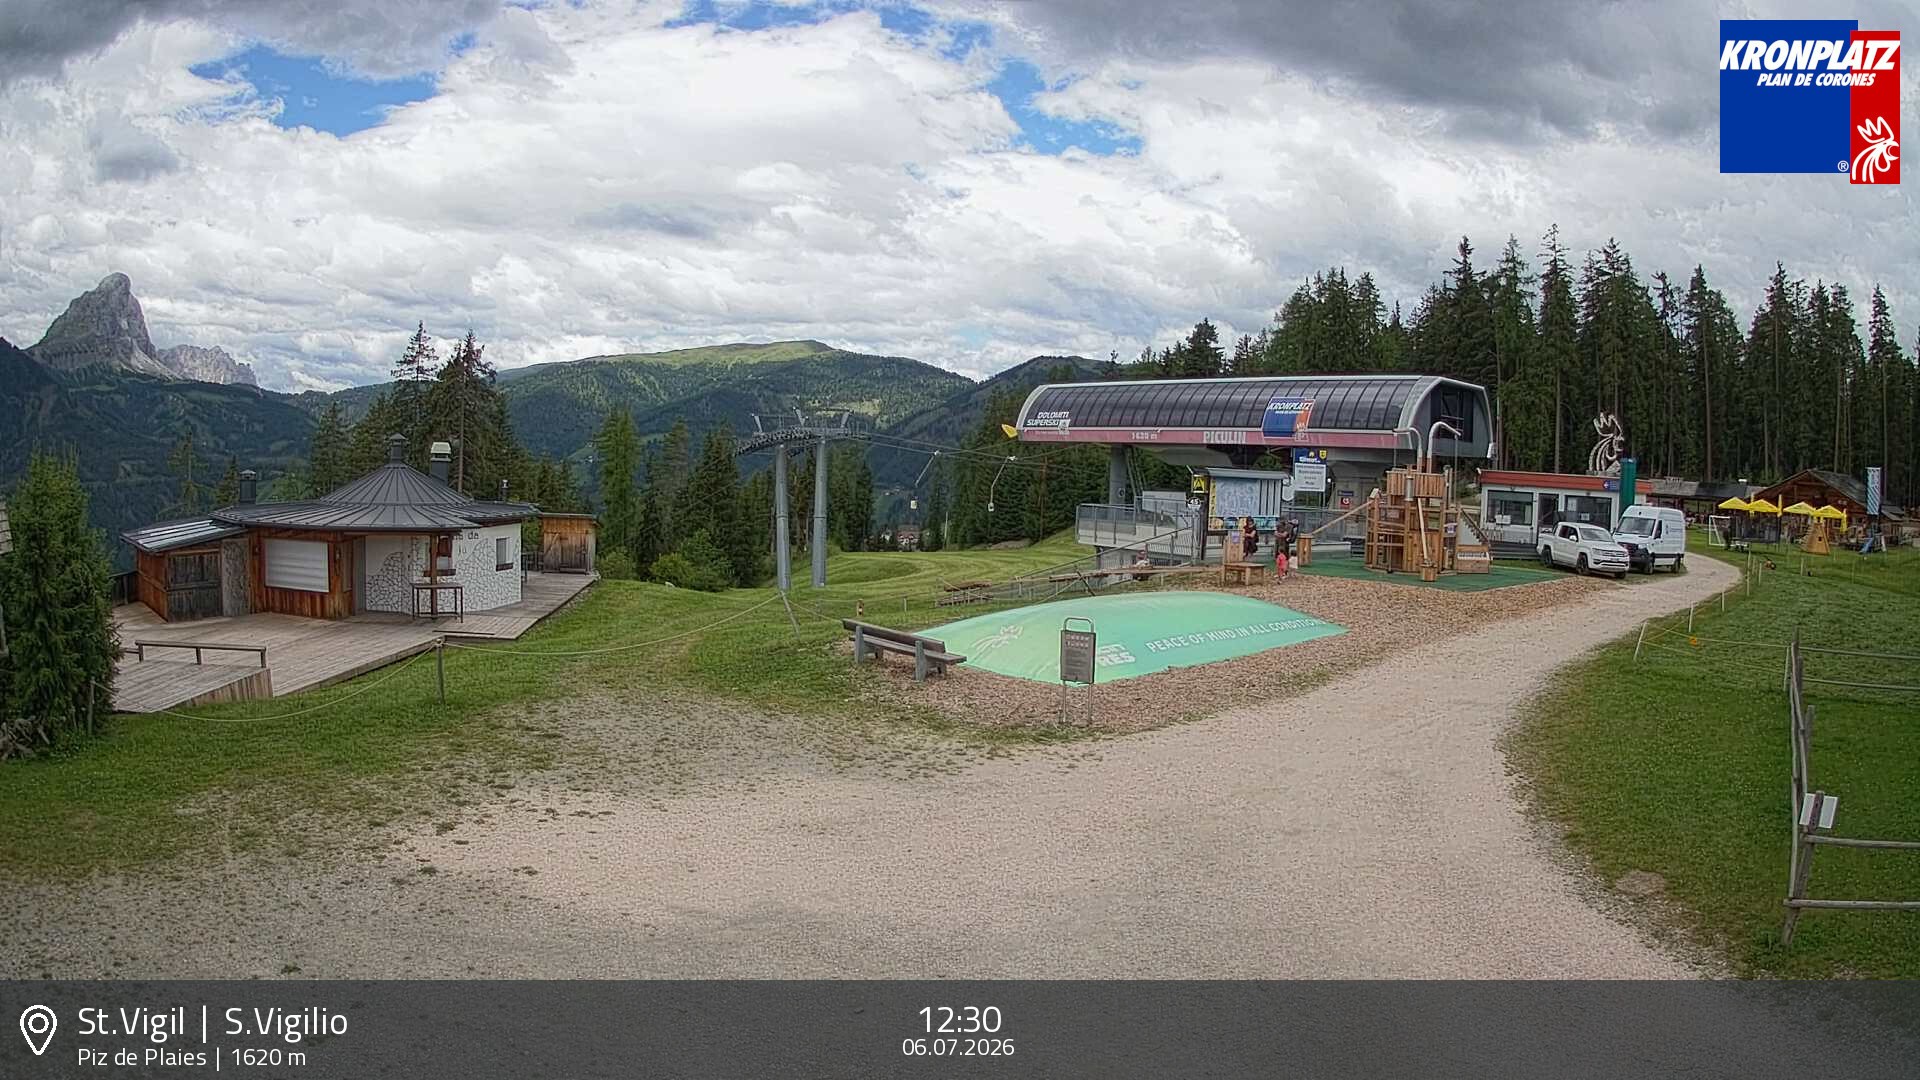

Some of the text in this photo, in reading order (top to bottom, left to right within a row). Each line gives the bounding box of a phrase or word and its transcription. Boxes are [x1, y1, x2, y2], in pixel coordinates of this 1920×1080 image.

[1268, 402, 1313, 410] KRONPLATZ
[1203, 431, 1247, 444] PICULIN
[1145, 635, 1189, 653] PEACE
[1188, 633, 1206, 644] OF
[1206, 629, 1235, 641] MIND
[1235, 627, 1252, 637] IN
[1249, 623, 1270, 635] ALL
